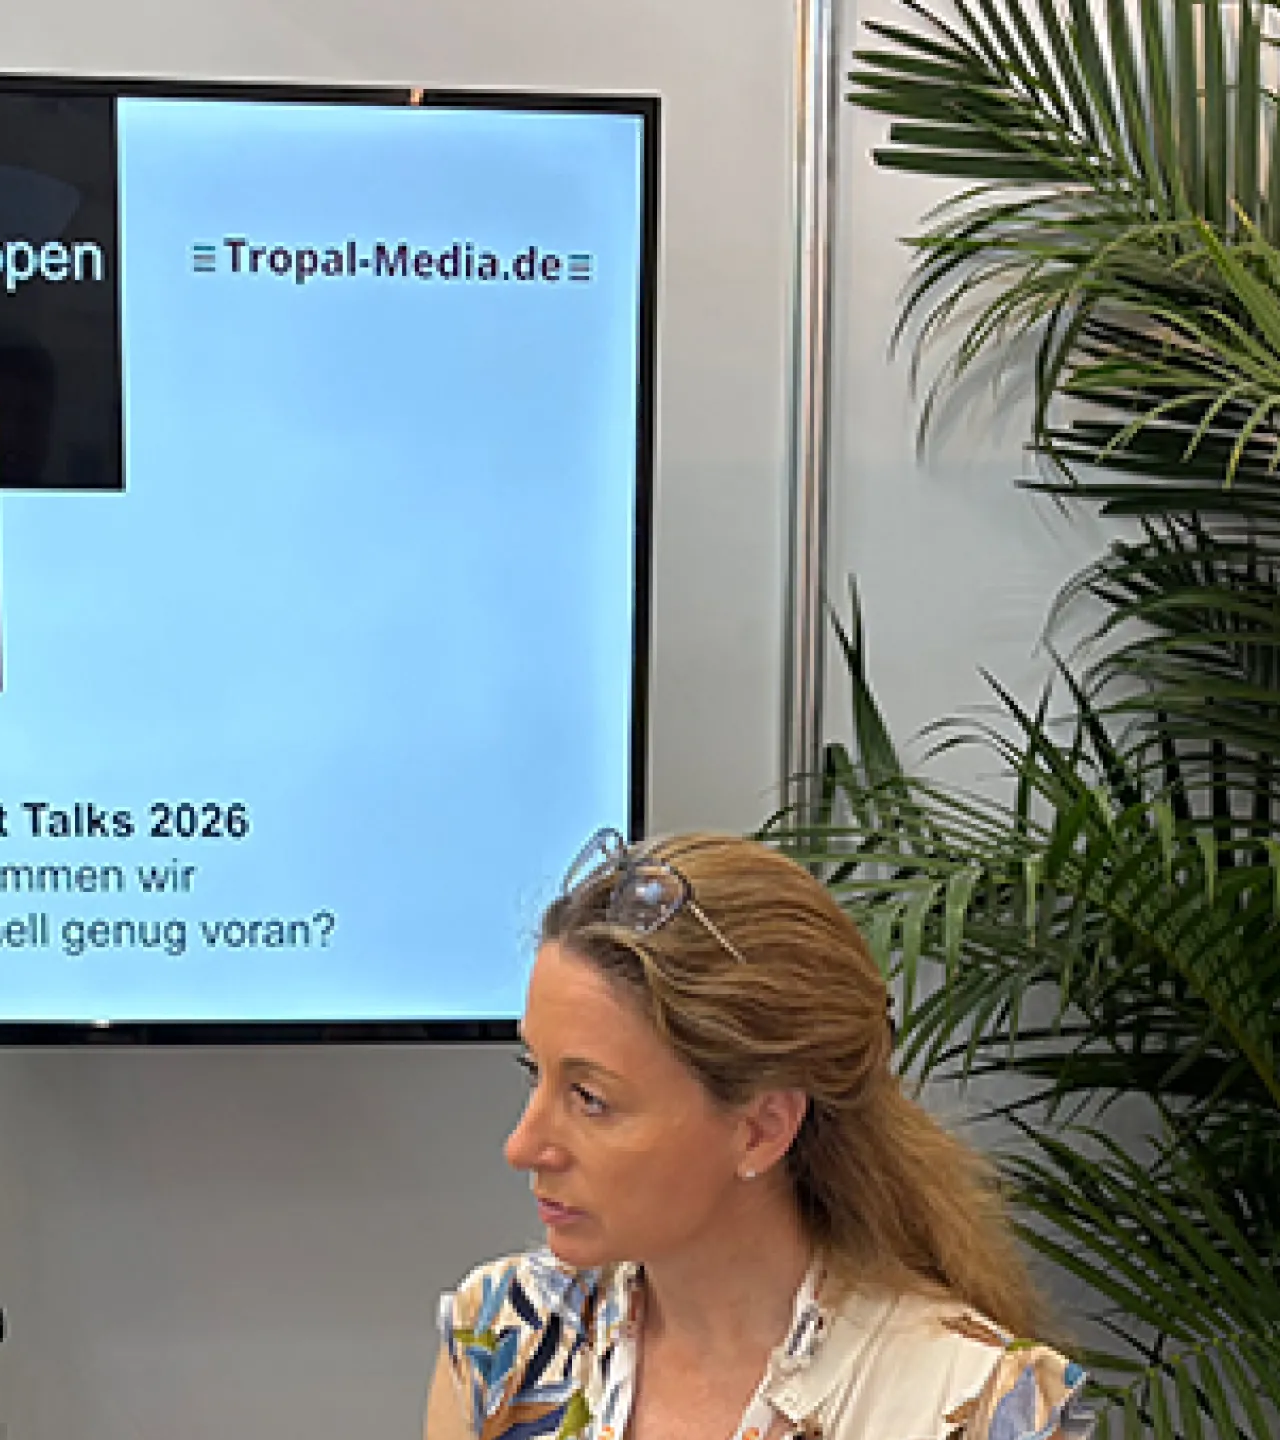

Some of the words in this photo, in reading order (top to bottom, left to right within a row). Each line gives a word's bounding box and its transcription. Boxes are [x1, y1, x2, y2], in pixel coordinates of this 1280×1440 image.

[224, 238, 560, 284] Tropal-Media.de
[24, 803, 134, 837] Talks
[151, 803, 249, 837] 2026
[139, 858, 194, 892] wir
[62, 918, 186, 956] genug
[202, 909, 334, 947] voran?
